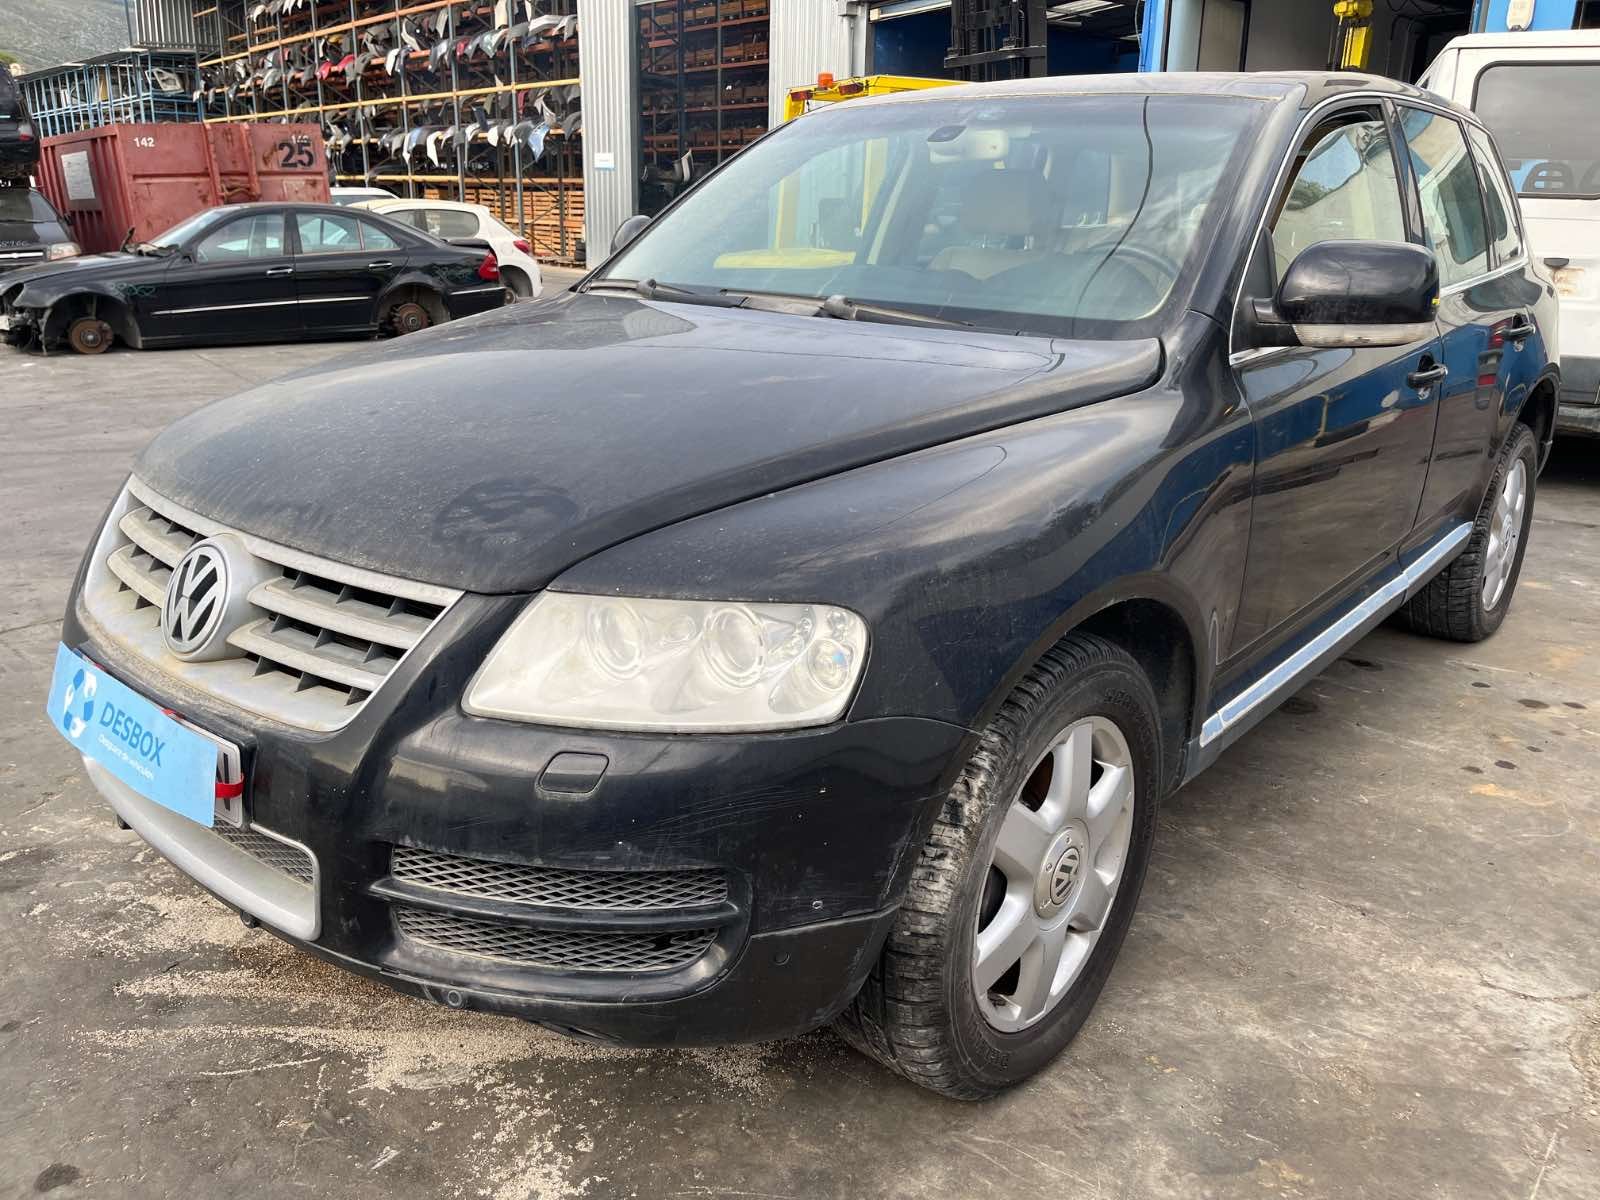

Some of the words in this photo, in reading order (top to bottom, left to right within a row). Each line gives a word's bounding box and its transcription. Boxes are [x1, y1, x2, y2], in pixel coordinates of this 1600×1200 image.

[133, 137, 155, 147] 142
[278, 142, 314, 168] 25
[99, 702, 166, 768] DESBOX
